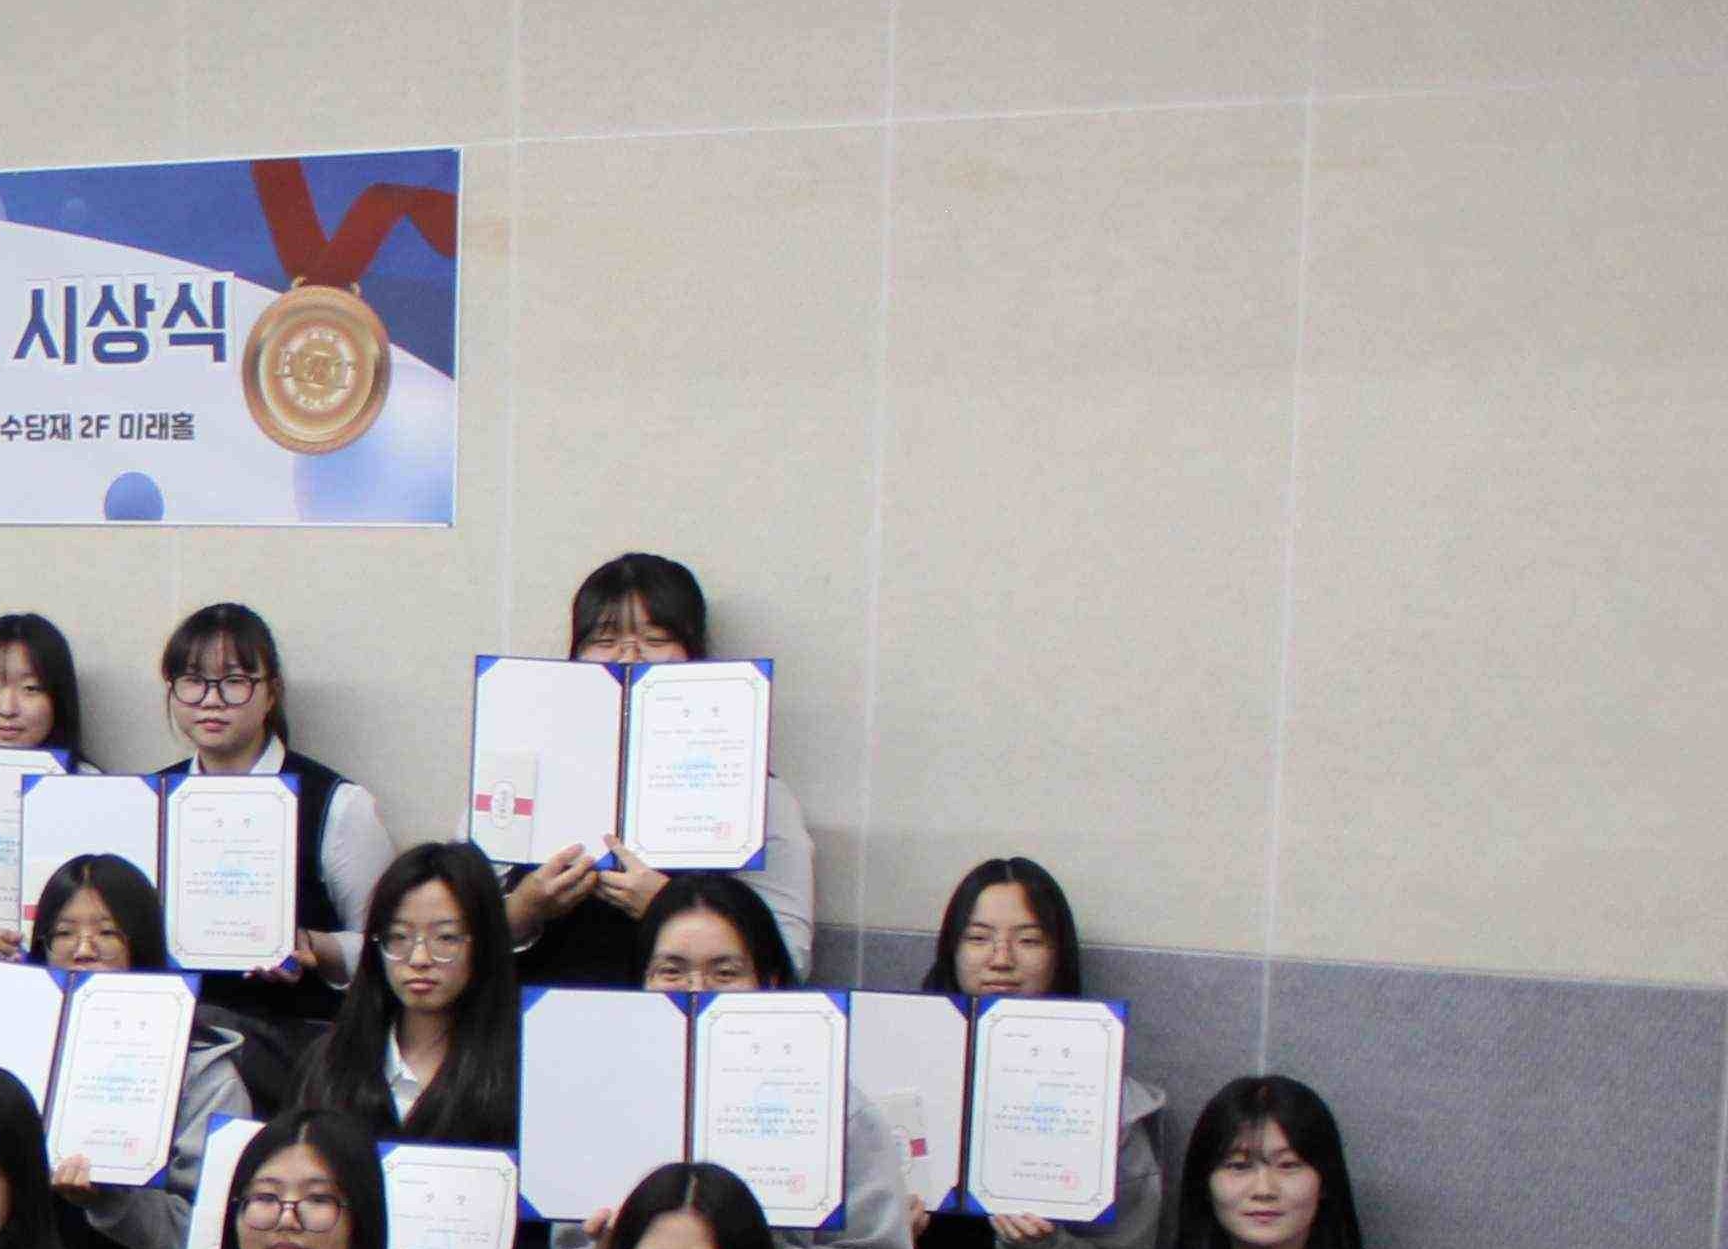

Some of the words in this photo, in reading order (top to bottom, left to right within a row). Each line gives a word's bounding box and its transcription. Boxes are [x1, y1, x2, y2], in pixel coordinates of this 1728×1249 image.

[12, 283, 227, 368] 시상식
[0, 412, 72, 442] 수당재
[79, 412, 111, 440] 2F
[118, 411, 196, 441] 미래홀
